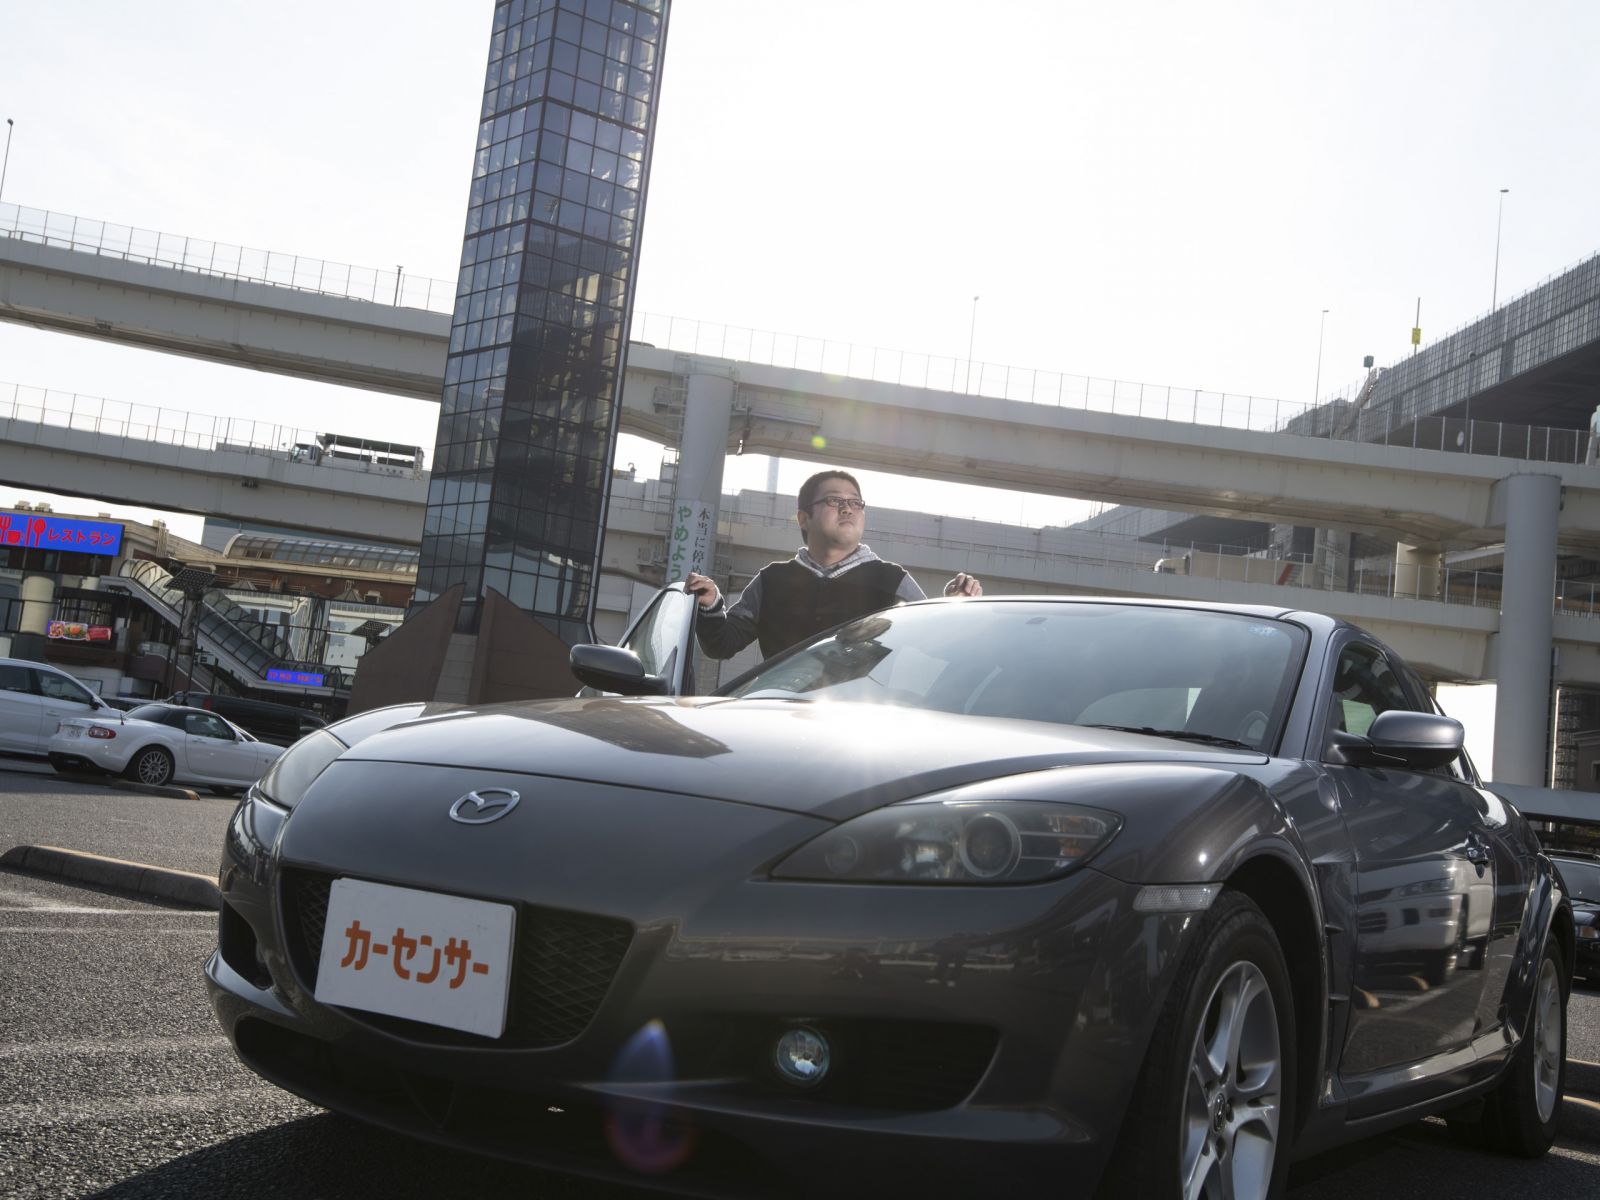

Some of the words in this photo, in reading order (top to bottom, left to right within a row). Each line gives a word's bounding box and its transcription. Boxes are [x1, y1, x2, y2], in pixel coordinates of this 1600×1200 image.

[47, 527, 115, 545] レストラン
[340, 920, 489, 989] カーセンサー
